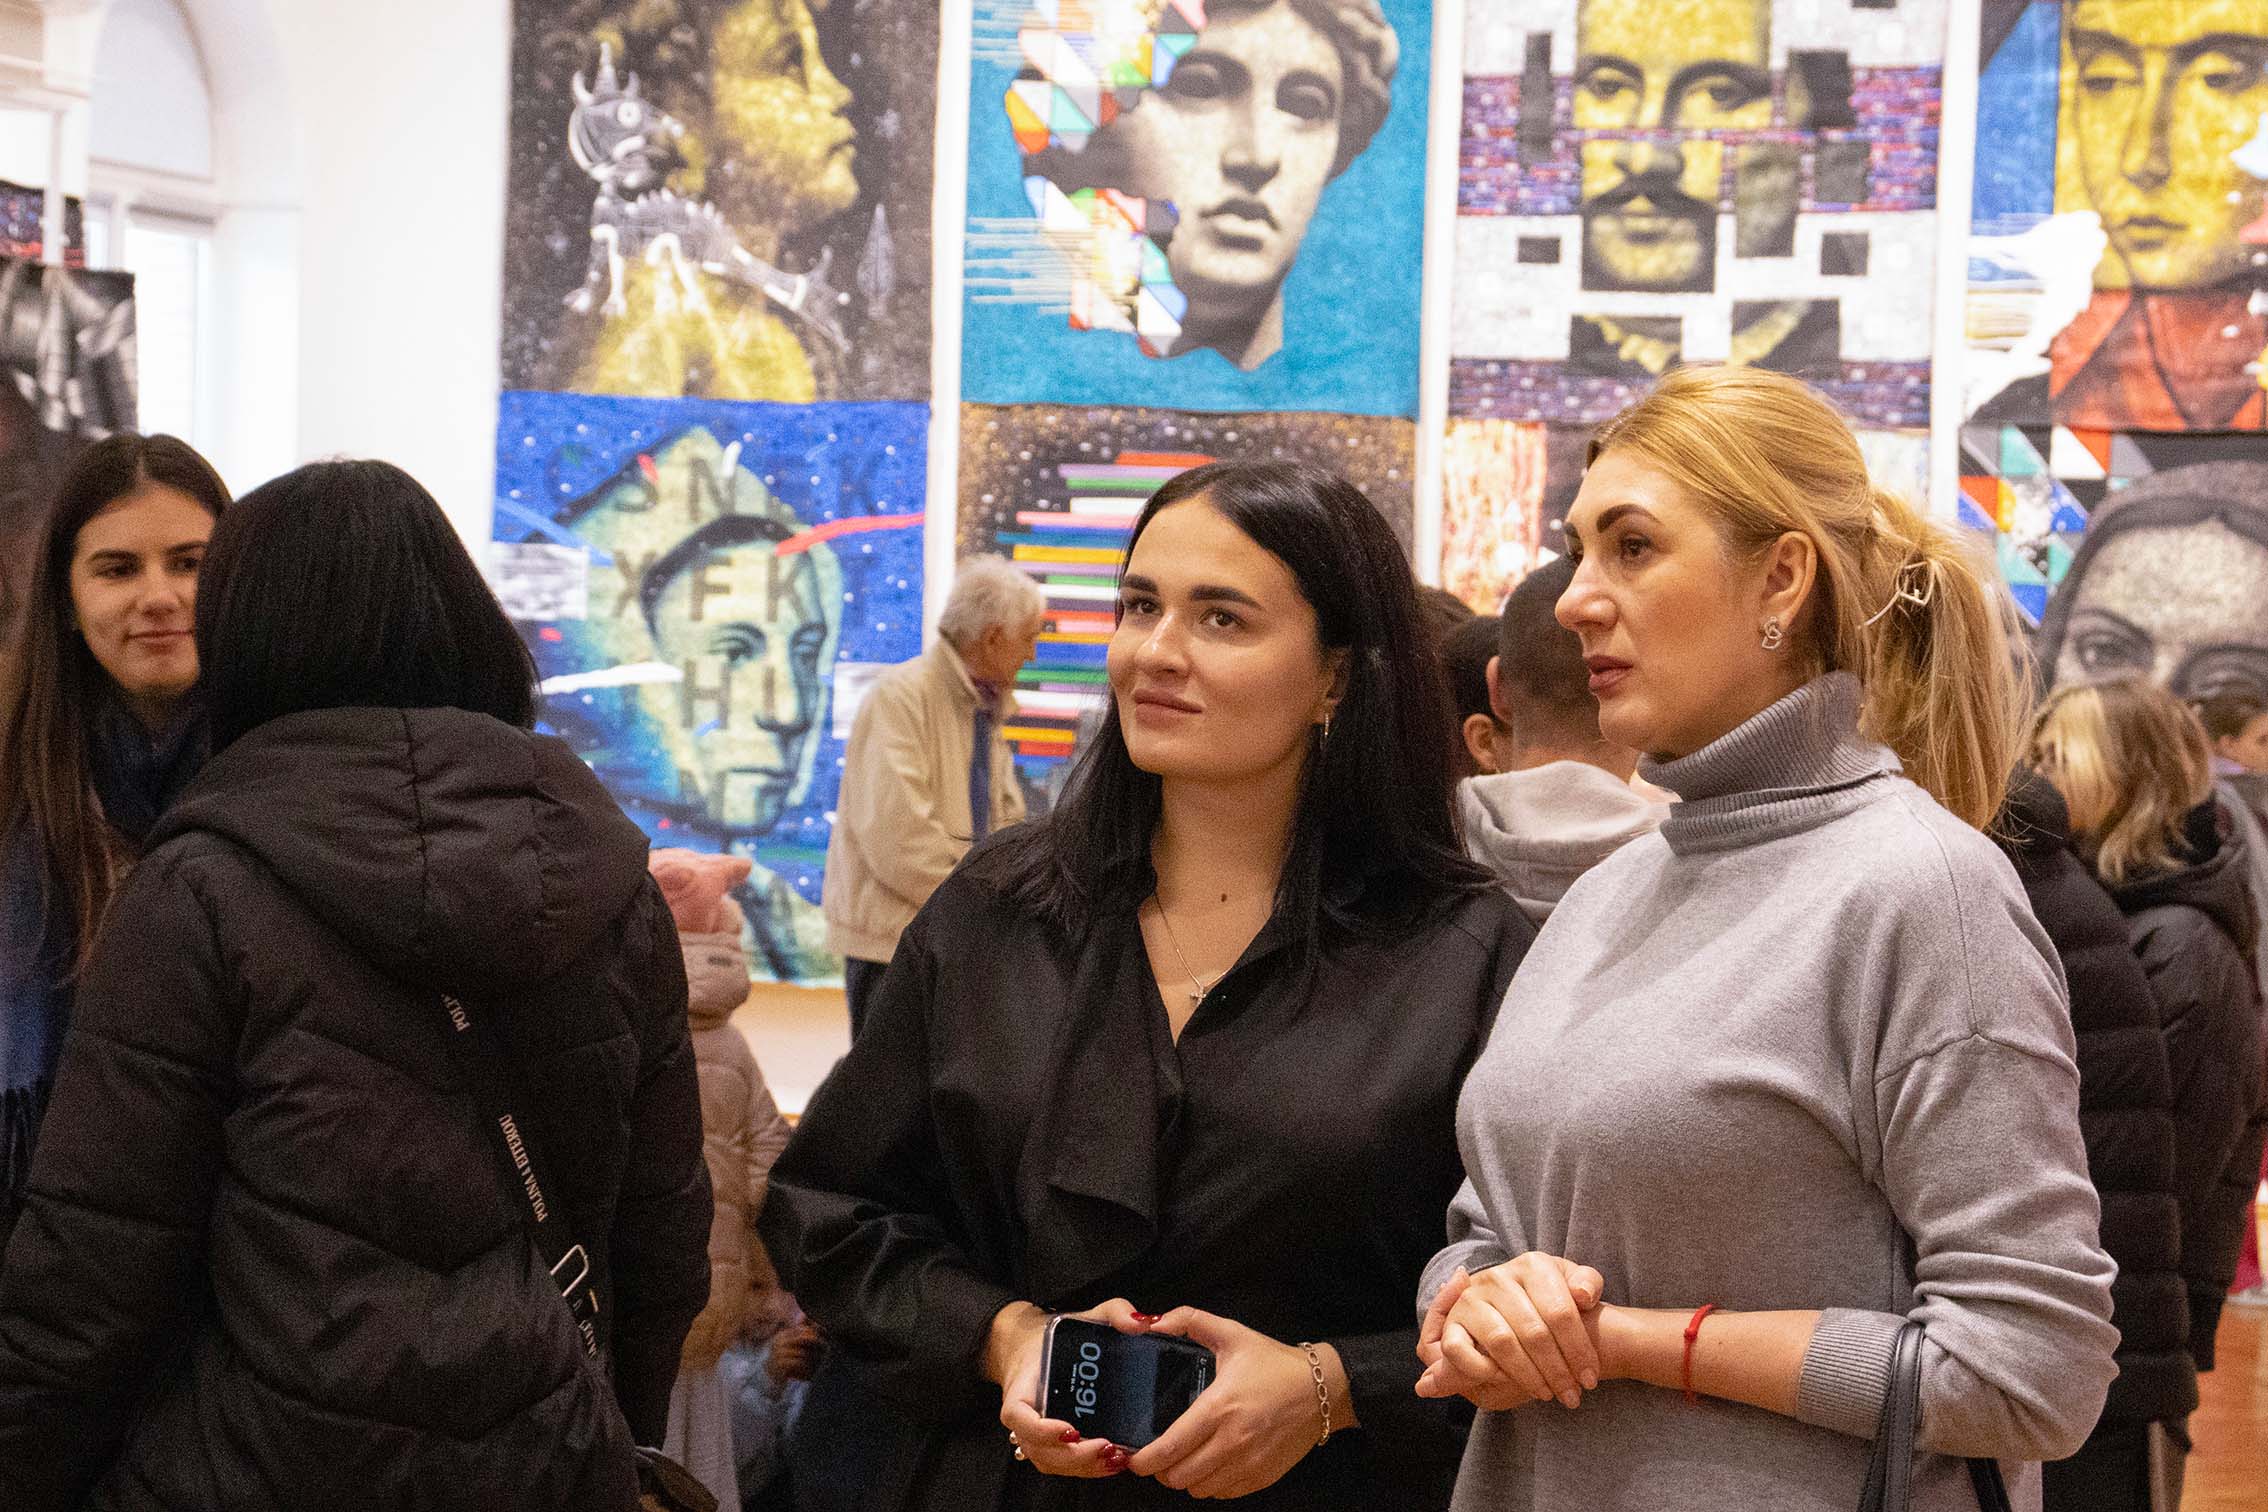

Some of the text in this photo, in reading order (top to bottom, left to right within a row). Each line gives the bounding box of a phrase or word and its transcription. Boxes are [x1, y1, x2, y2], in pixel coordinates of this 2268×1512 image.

[499, 1114, 529, 1170] EITEROU
[524, 1173, 549, 1222] POLINA
[1075, 1342, 1101, 1418] 16:00
